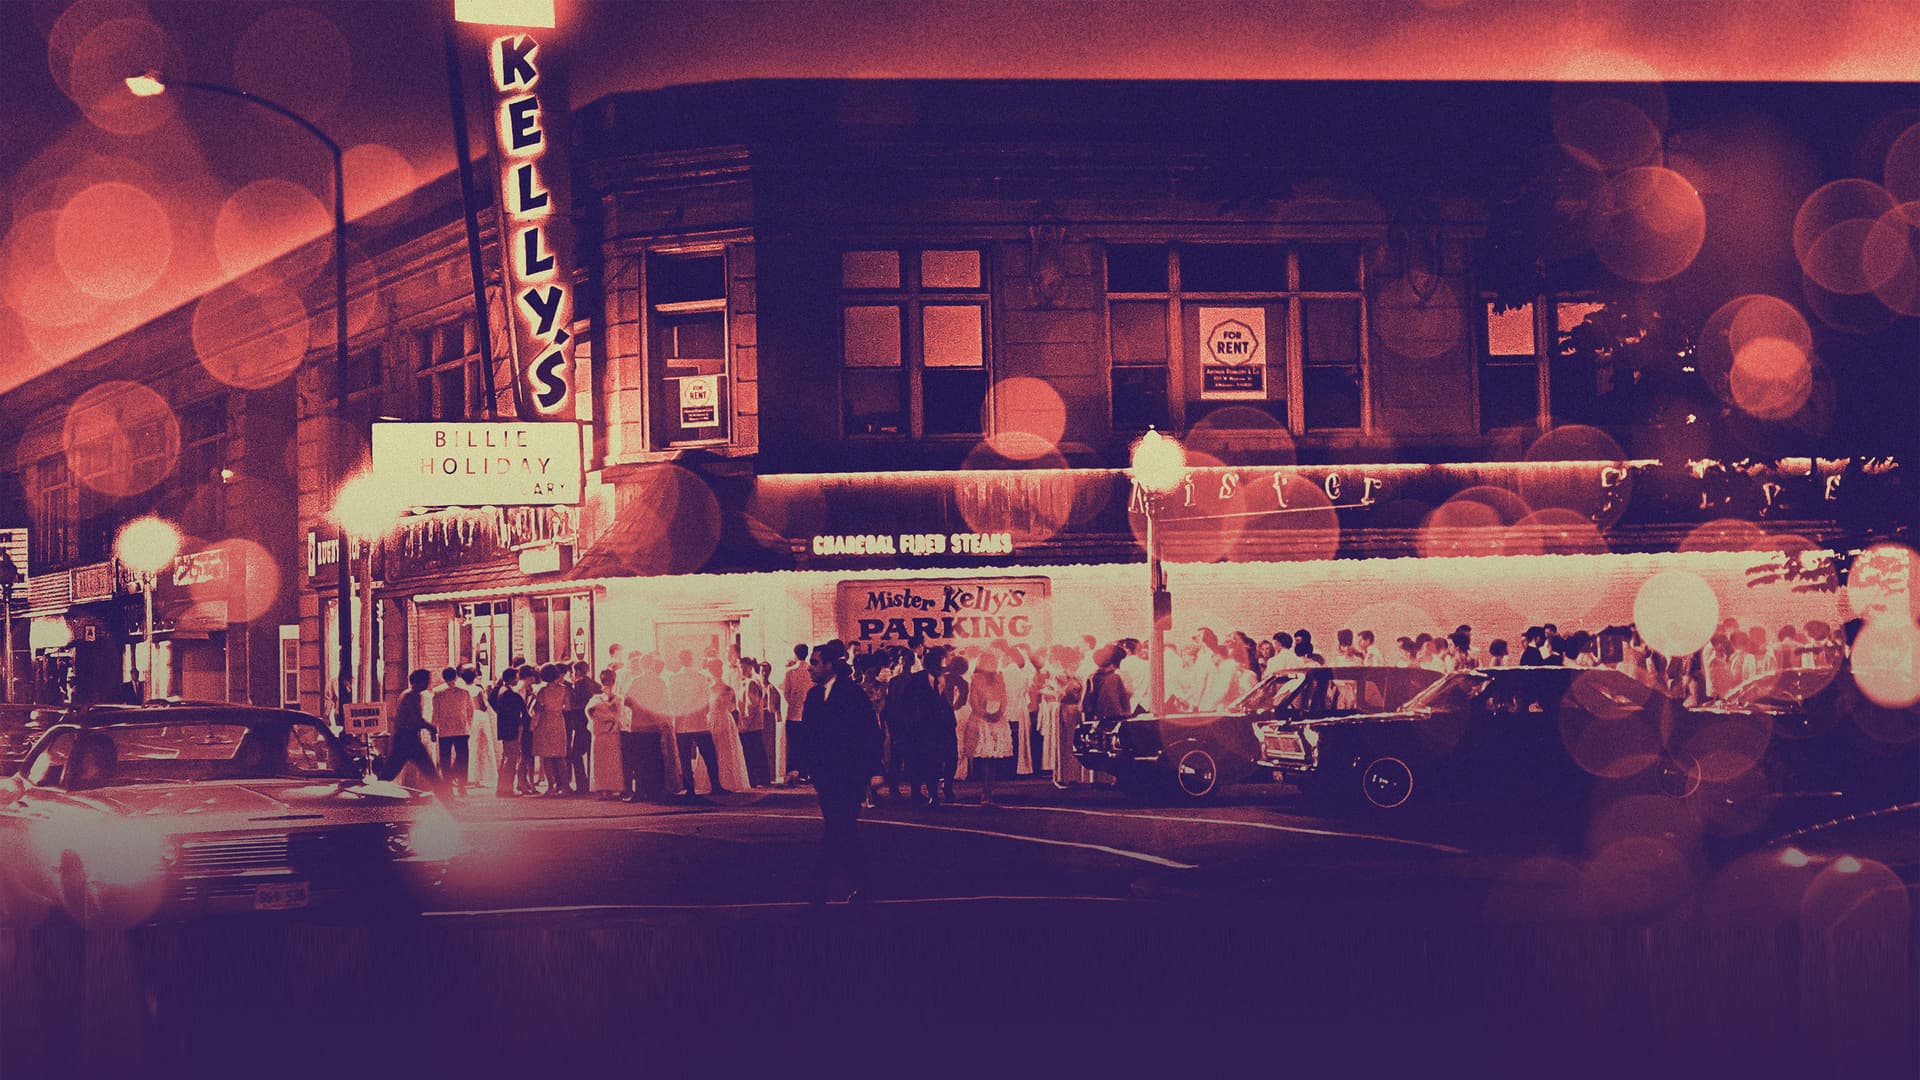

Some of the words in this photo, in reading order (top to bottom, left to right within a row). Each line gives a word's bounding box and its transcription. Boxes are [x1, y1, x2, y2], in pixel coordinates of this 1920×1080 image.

[498, 33, 570, 409] KELLY'S
[1223, 331, 1242, 339] FOR
[1217, 341, 1250, 354] RENT
[435, 430, 528, 448] BILLIE
[420, 457, 551, 475] HOLIDAY
[812, 534, 897, 555] CHARCOAL
[899, 533, 947, 556] FIRED
[950, 533, 1013, 554] STEAKS
[864, 587, 936, 612] Mister
[941, 585, 1026, 615] Kelly's
[858, 615, 1033, 641] PARKING
